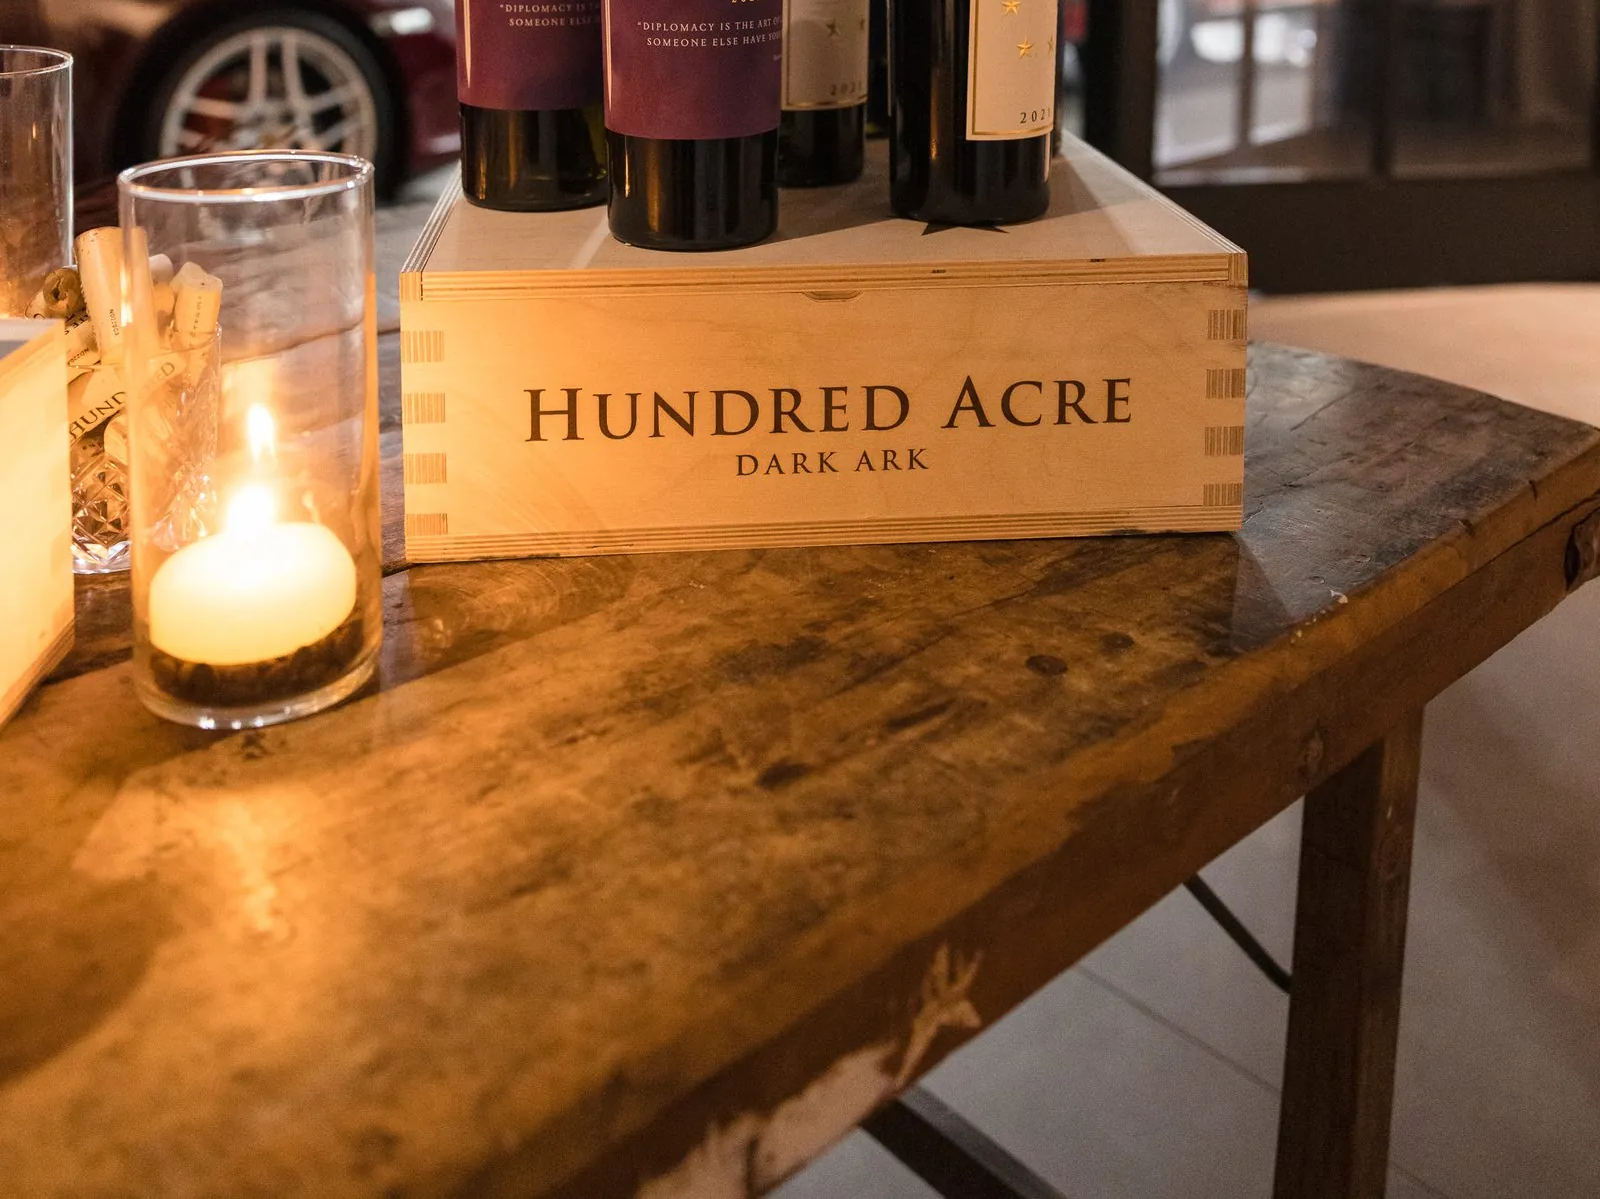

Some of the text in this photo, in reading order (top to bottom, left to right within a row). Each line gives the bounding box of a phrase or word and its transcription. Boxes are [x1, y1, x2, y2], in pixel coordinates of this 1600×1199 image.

[509, 17, 565, 27] SOMEONE
[720, 22, 731, 31] IS
[734, 20, 754, 30] THE
[757, 17, 771, 28] ART
[646, 37, 707, 47] SOMEONE
[712, 37, 738, 47] ELSE
[743, 34, 766, 45] HAVE
[523, 374, 1134, 444] HUNDRED ACRE
[735, 446, 931, 478] DARK ARK
